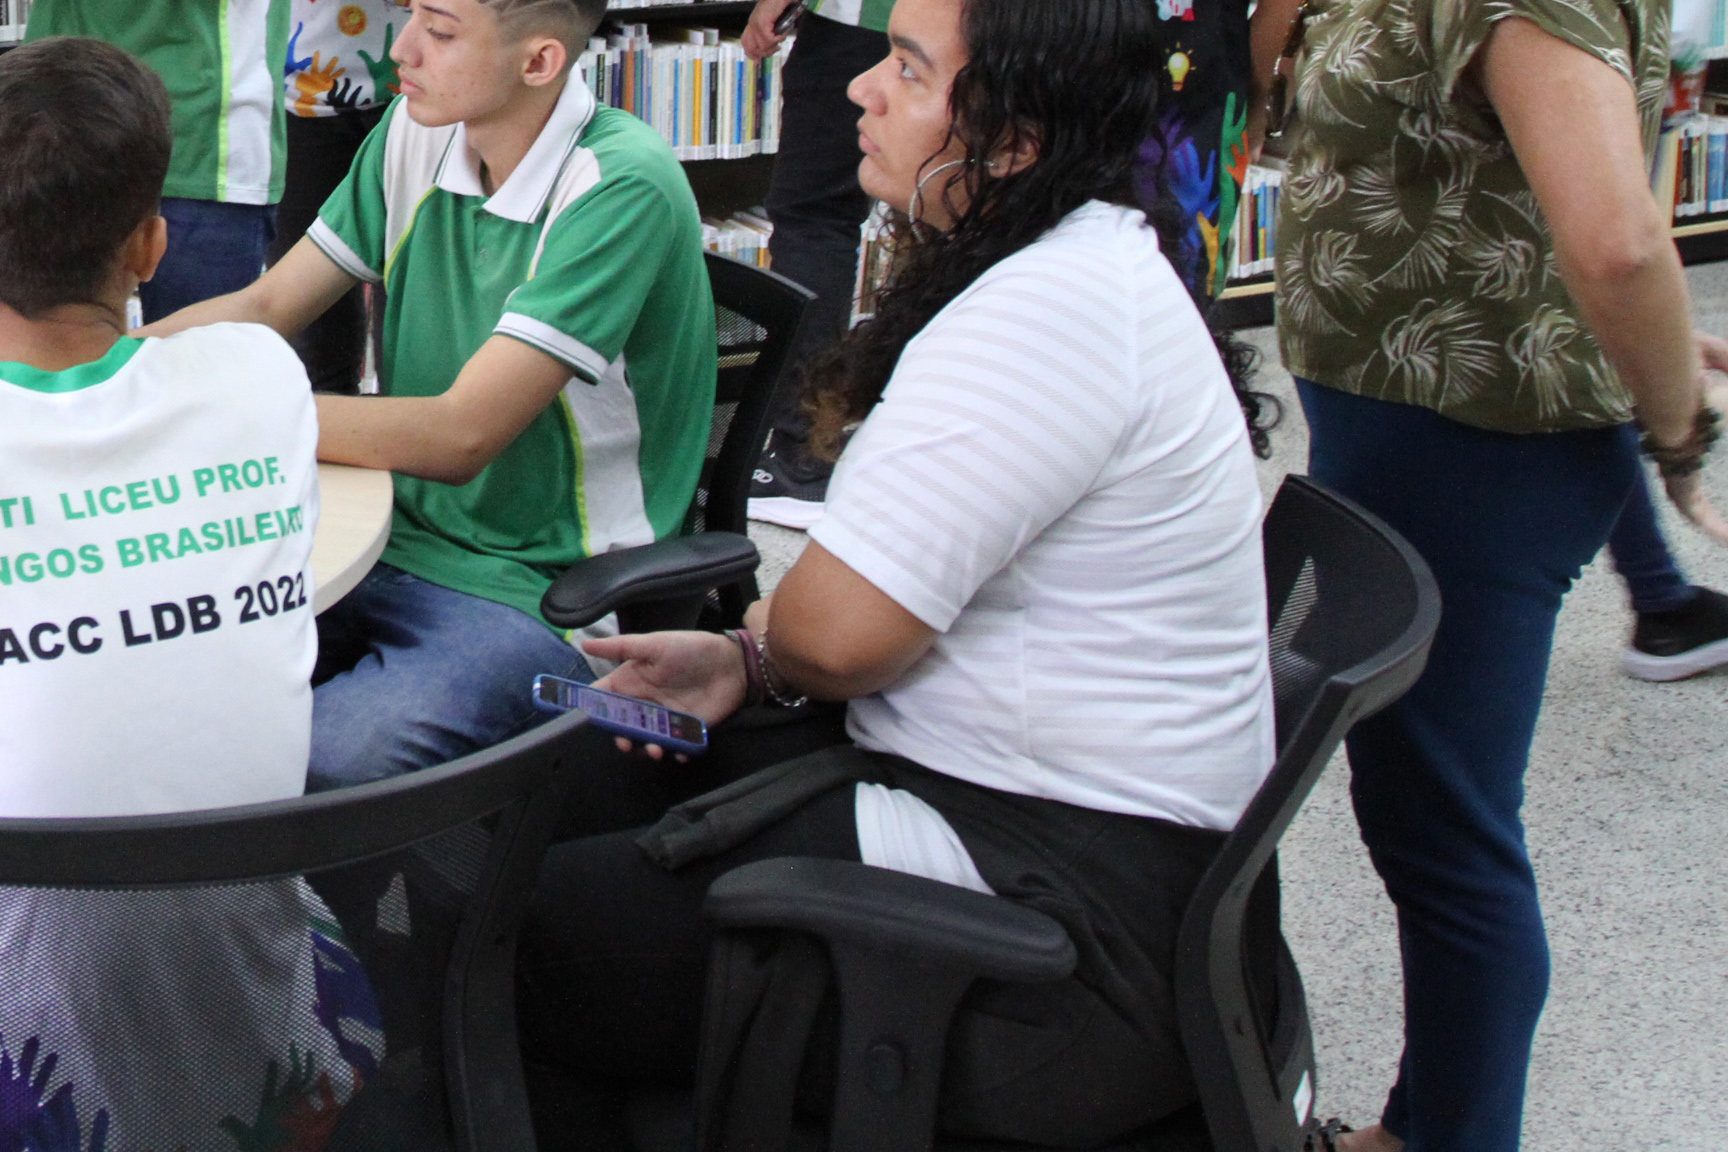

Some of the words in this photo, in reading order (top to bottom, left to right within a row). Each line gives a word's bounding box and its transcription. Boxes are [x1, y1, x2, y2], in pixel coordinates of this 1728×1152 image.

[60, 474, 181, 521] LICEU
[191, 456, 286, 498] PROF.
[119, 593, 222, 648] LDB
[234, 571, 307, 625] 2022
